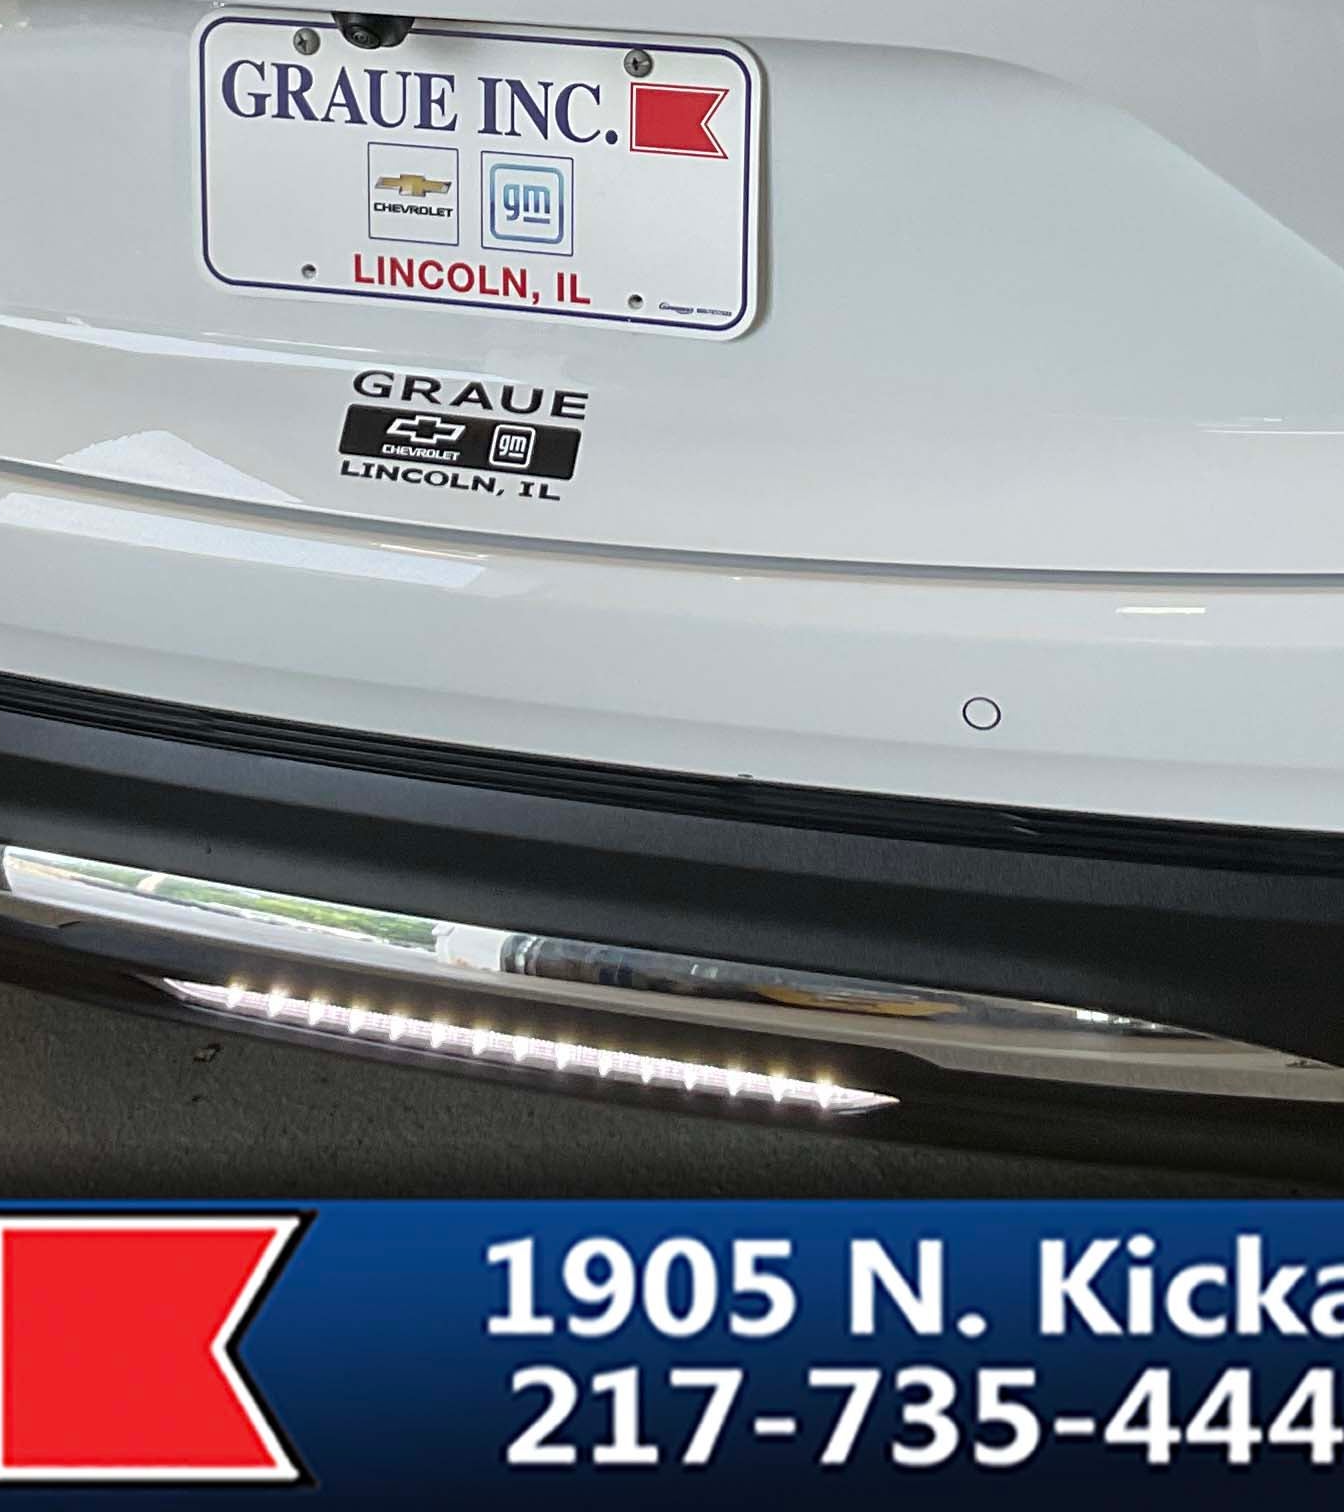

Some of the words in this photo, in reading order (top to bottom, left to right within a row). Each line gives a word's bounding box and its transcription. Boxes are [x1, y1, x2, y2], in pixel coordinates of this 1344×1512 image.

[220, 58, 459, 132] GRAUE
[476, 76, 619, 146] INC.
[373, 201, 454, 219] CHEVROLET
[503, 183, 551, 222] gm
[353, 253, 541, 305] LINCOLN,
[556, 271, 591, 305] IL
[353, 369, 589, 421] GRAUE
[381, 444, 461, 461] CHEVROLET
[498, 434, 527, 456] gm
[340, 460, 504, 497] LINCOLN,
[518, 480, 561, 501] IL
